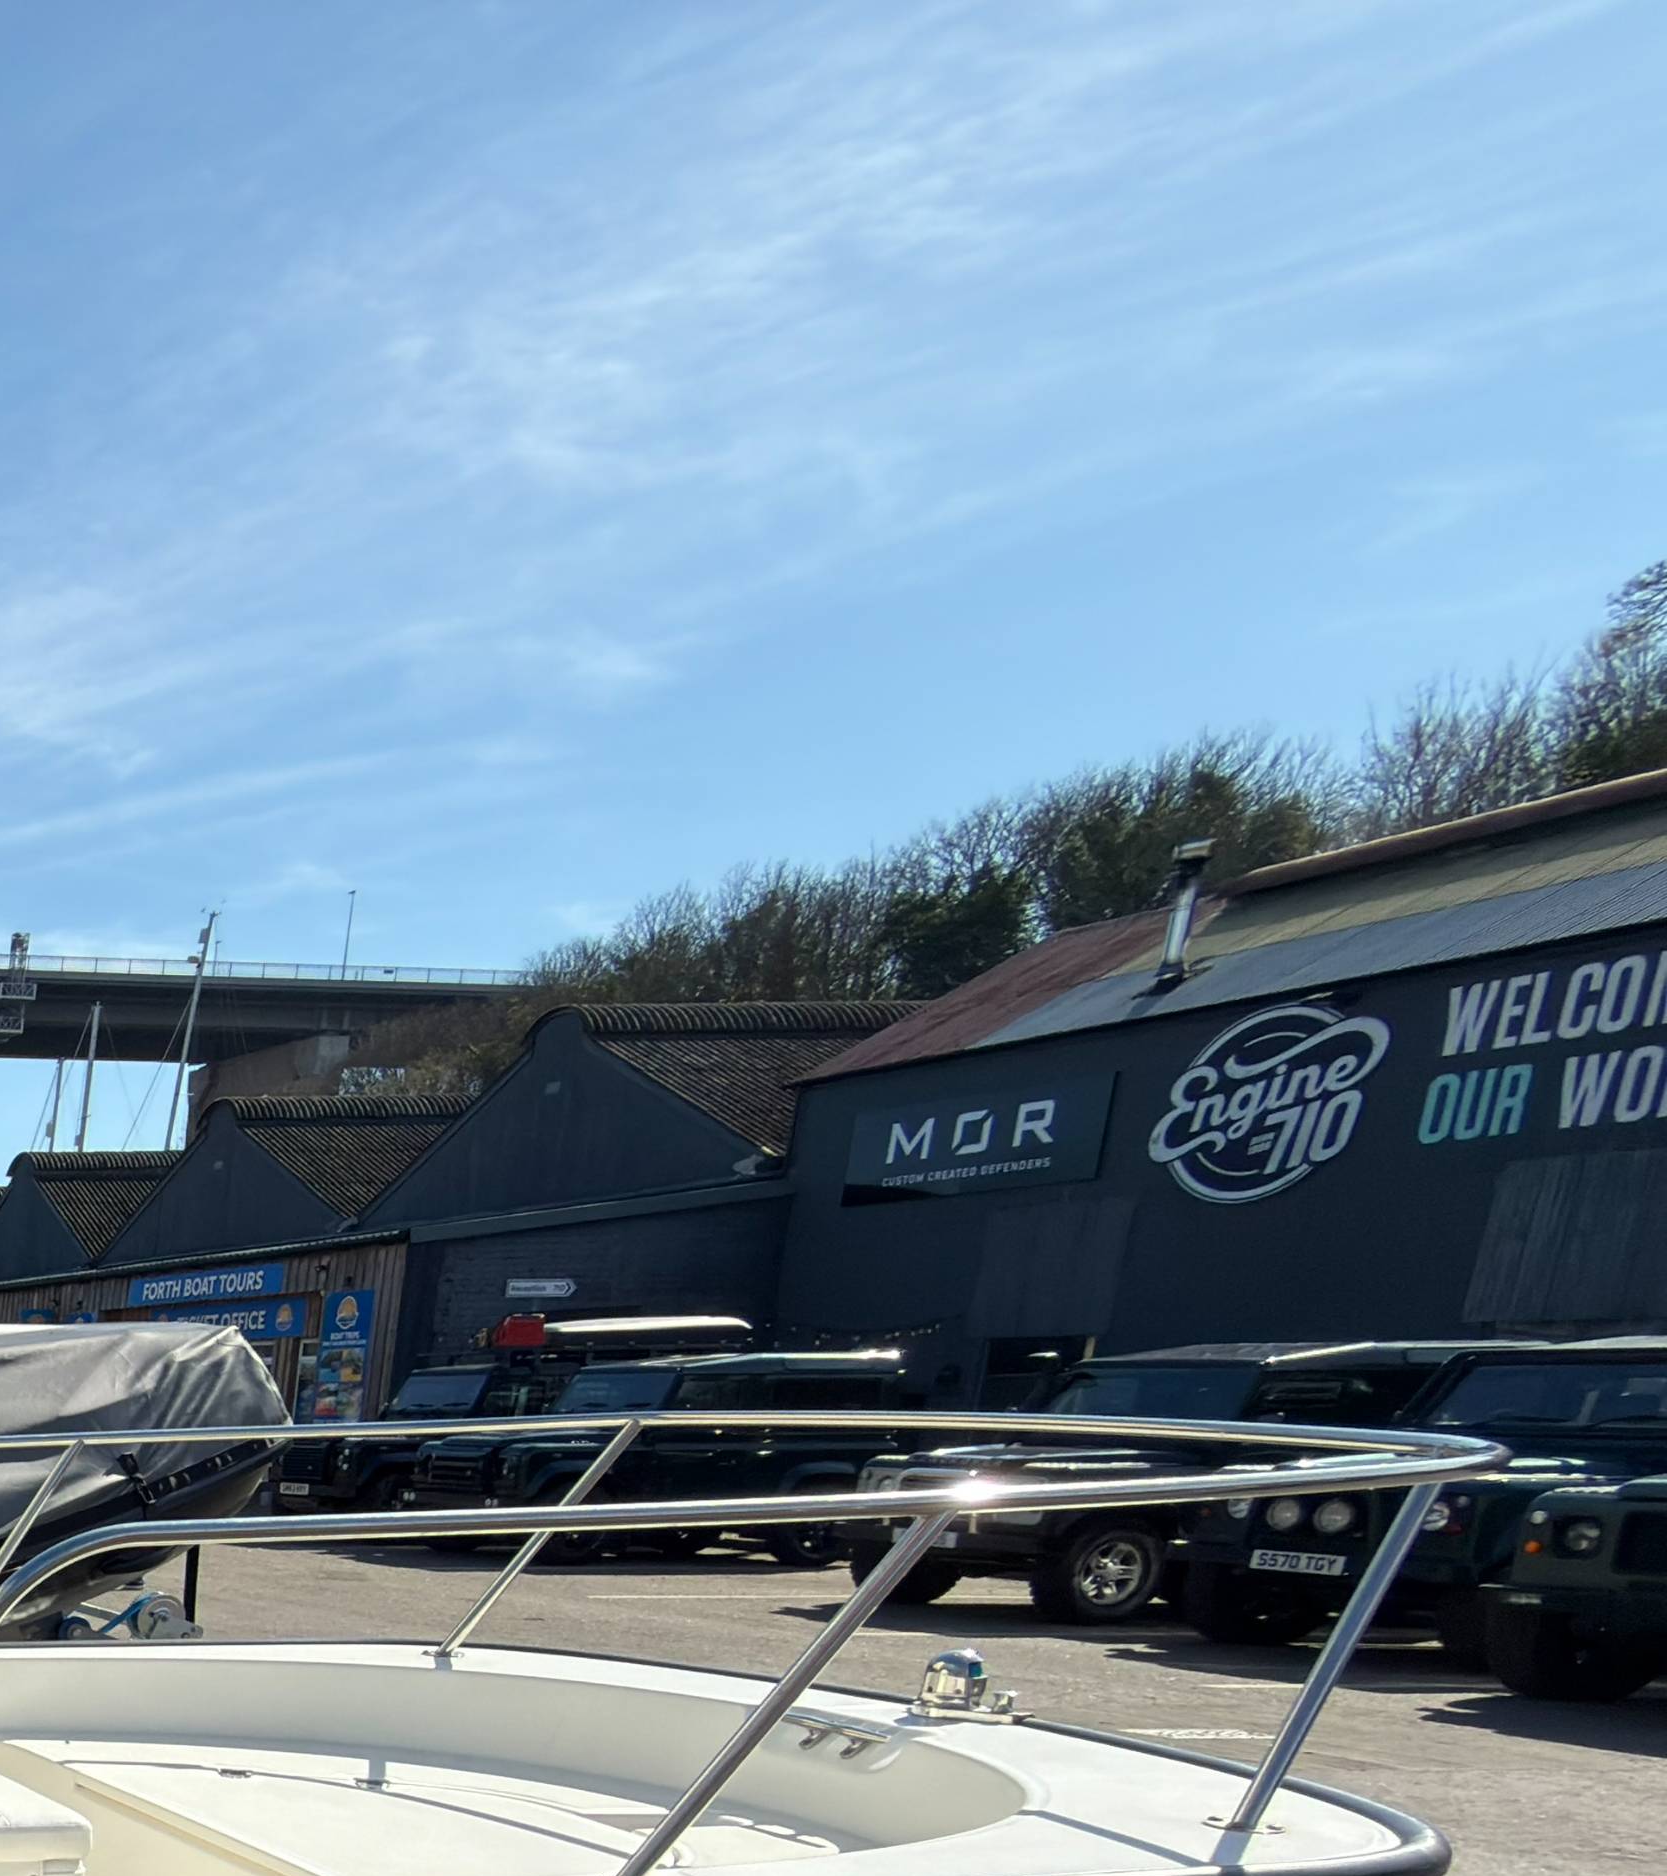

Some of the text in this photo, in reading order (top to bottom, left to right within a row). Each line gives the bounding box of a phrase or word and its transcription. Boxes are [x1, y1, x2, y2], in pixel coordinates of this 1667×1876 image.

[1148, 1016, 1390, 1163] Engine
[1418, 1045, 1667, 1144] OUR WO
[885, 1099, 1055, 1165] MOR
[1263, 1089, 1363, 1175] 710
[882, 1157, 1052, 1188] CUSTOM CREATED DEFENDERS
[142, 1270, 265, 1301] FORTH BOAT TOURS
[221, 1310, 267, 1331] OFFICE
[1258, 1553, 1337, 1571] S570 TGY
